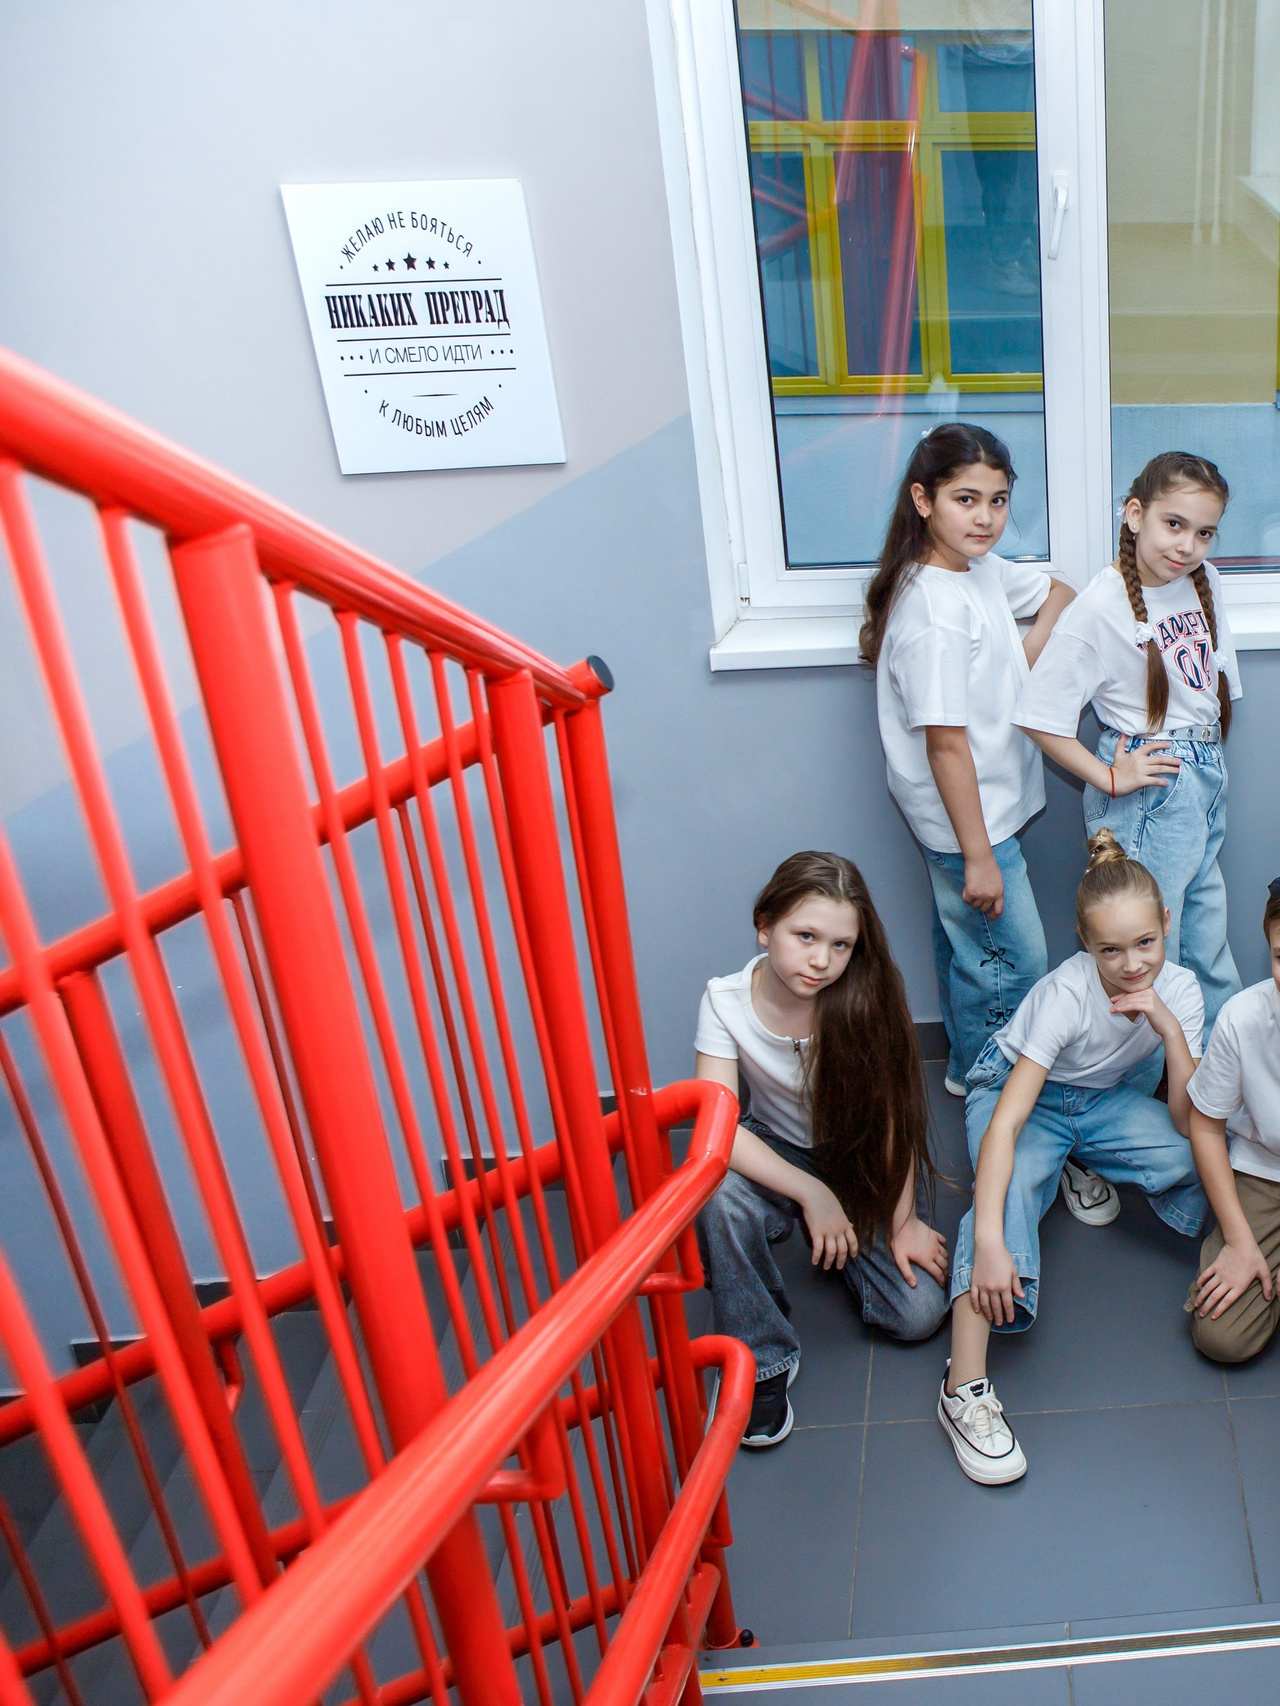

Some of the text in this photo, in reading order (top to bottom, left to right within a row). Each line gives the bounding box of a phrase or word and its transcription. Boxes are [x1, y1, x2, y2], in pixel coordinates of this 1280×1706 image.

[340, 210, 473, 263] ЖЕЛАЮ НЕ БОЯТЬСЯ
[324, 289, 511, 330] НИКАКИХ ПРЕГРАД
[369, 344, 483, 364] И СМЕЛО ИДТИ
[378, 395, 495, 438] К ЛЮБЫМ ЦЕЛЯМ
